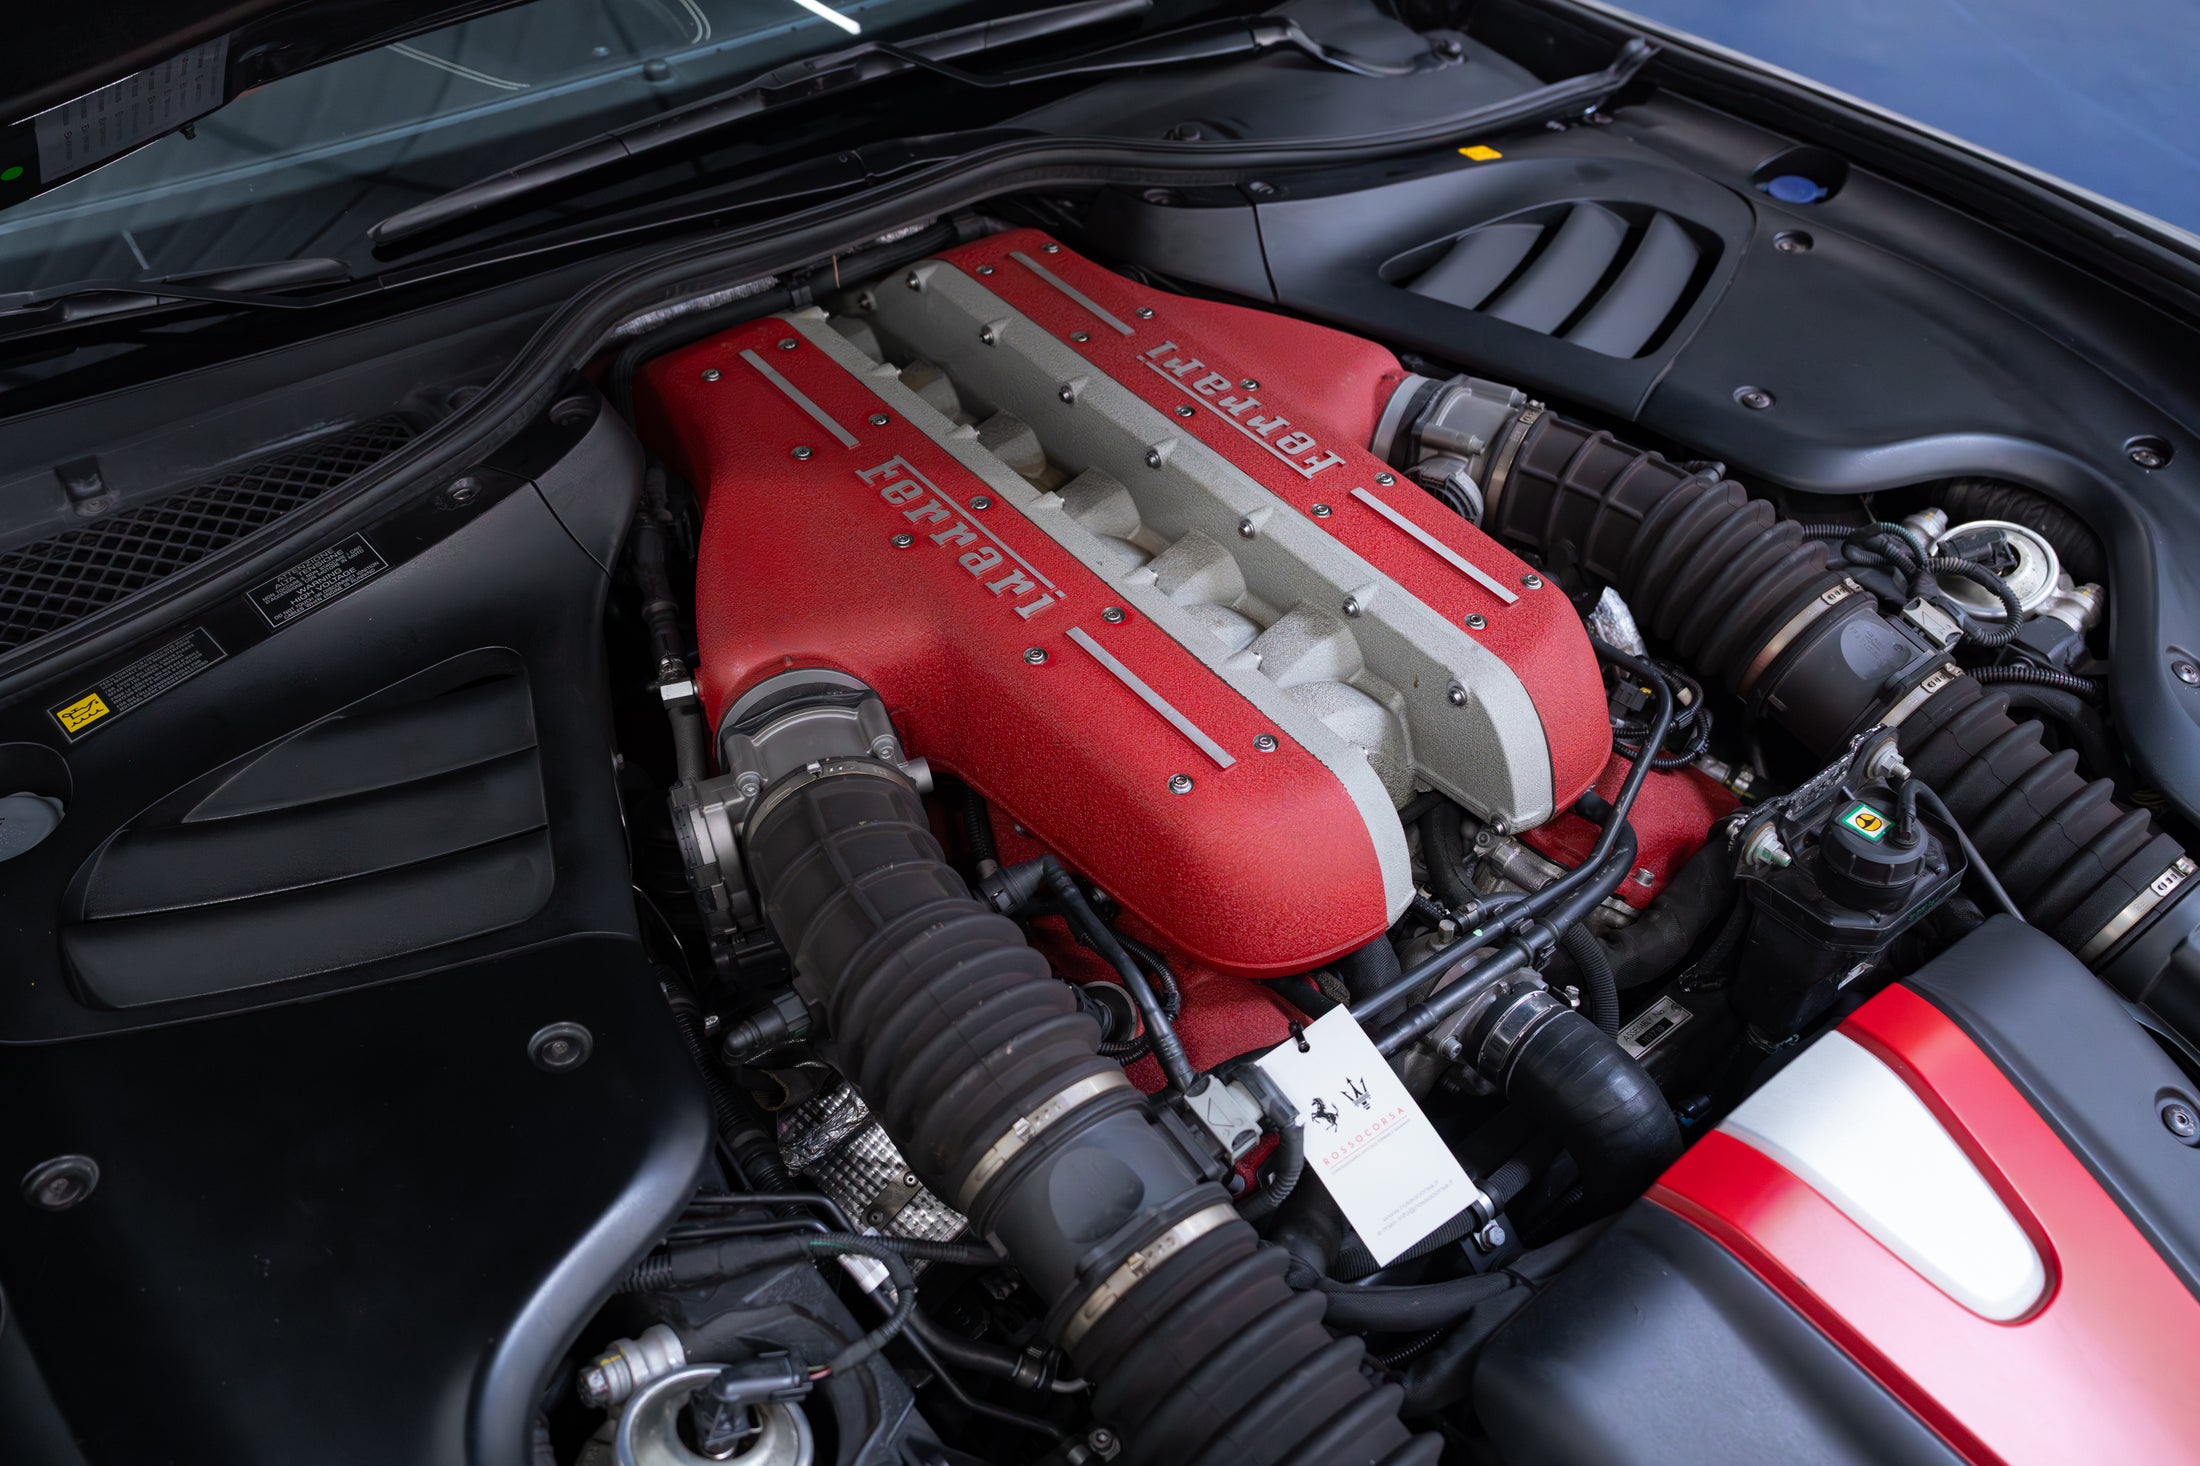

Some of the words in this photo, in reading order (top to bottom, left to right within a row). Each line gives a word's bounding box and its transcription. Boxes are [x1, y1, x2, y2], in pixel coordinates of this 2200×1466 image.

[1136, 340, 1346, 479] Ferrari
[855, 454, 1066, 621] Ferrari
[273, 574, 296, 590] ALTA
[296, 548, 344, 577] TENSIONE
[275, 548, 334, 582] ATTENZIONE
[295, 567, 343, 595] WARNING
[289, 589, 315, 605] HIGH
[314, 566, 357, 591] VOLTAGE
[272, 612, 283, 620] DO
[281, 606, 295, 615] NOT
[294, 596, 314, 608] TOUCH
[1623, 1016, 1654, 1042] ASSEMBLY
[1323, 1107, 1404, 1166] ROSSOCORSA
